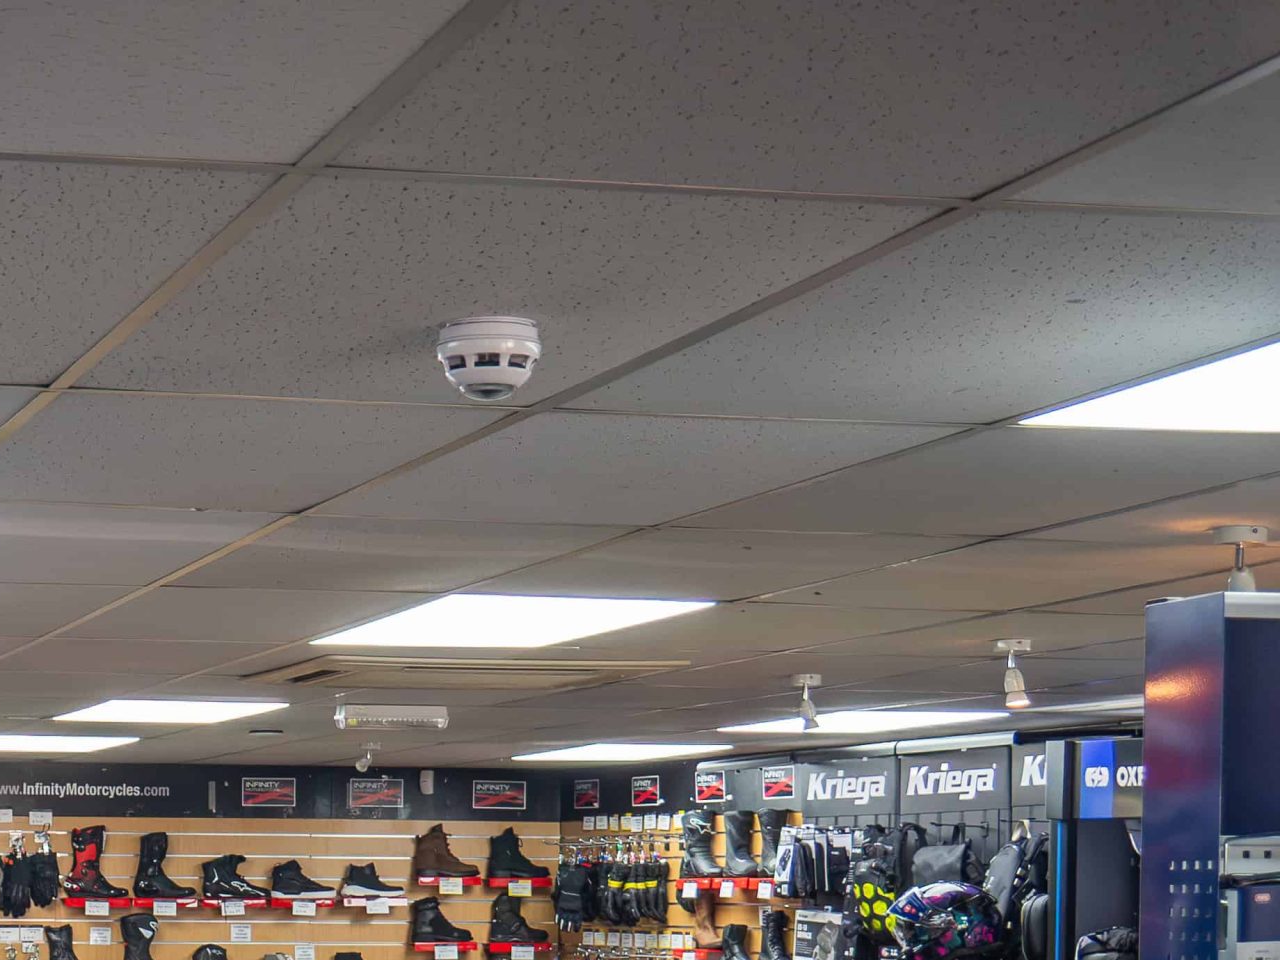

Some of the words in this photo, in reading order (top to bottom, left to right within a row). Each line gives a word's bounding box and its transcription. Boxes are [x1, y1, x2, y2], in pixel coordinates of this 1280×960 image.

[807, 770, 886, 806] Kriega
[906, 762, 995, 801] Kriega
[1115, 765, 1145, 788] OXF
